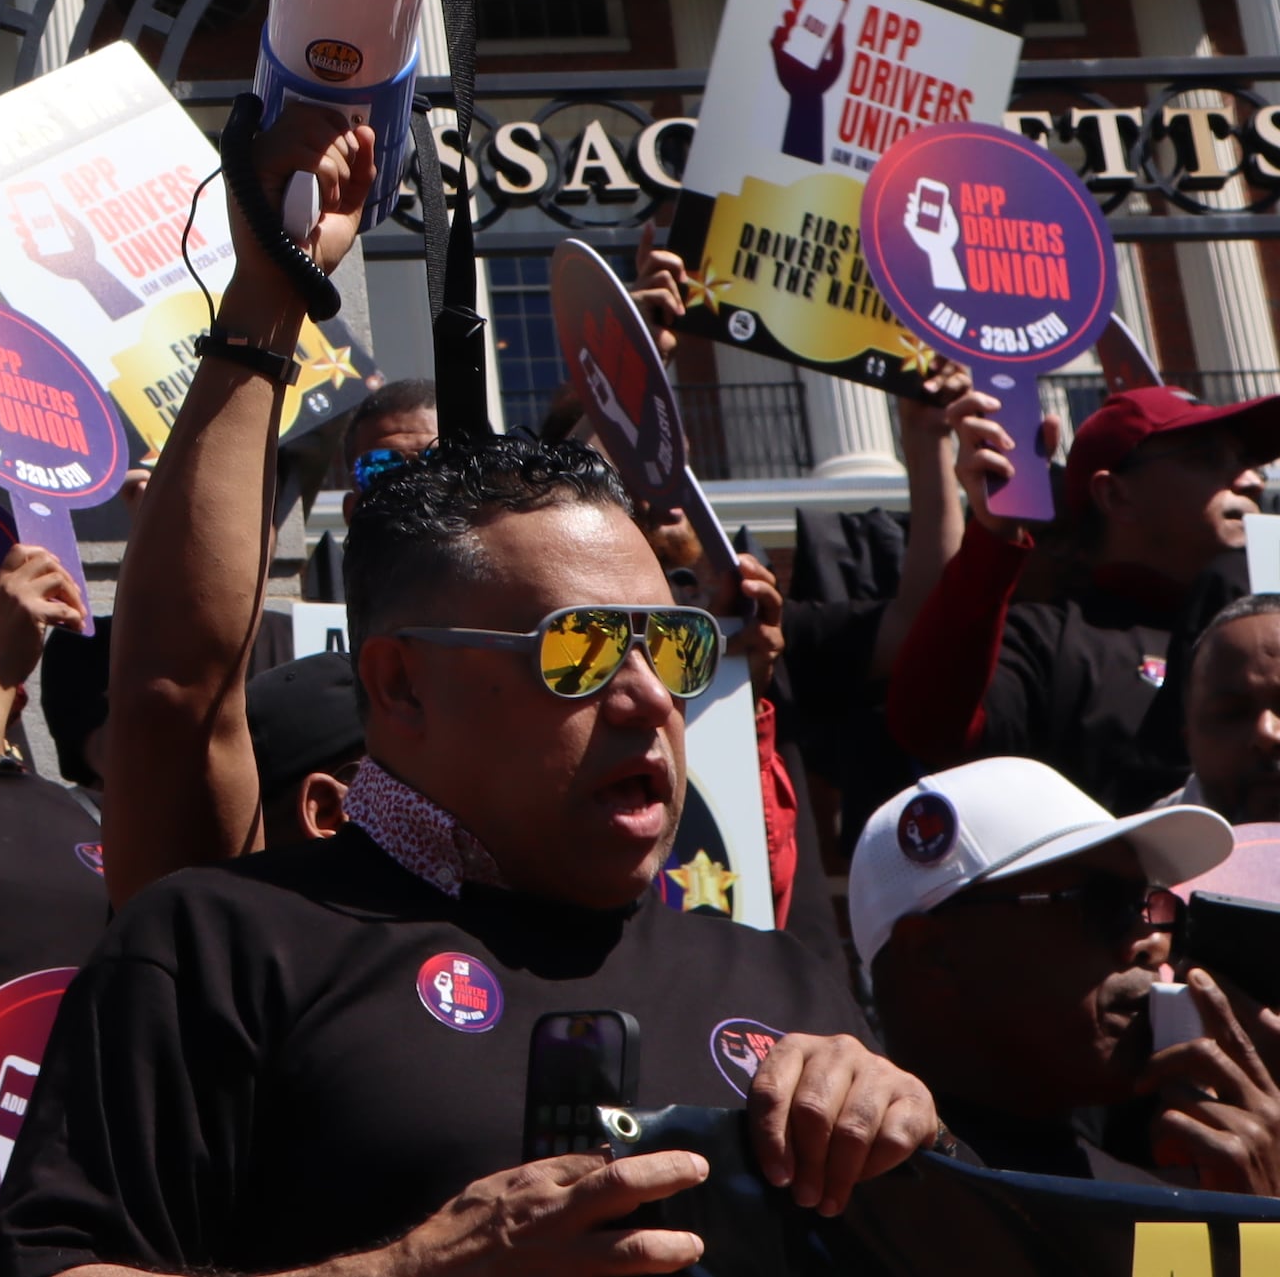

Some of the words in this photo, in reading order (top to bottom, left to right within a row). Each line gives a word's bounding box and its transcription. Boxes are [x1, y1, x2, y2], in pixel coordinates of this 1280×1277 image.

[858, 5, 922, 62] APP
[848, 51, 975, 124] DRIVERS
[61, 156, 121, 207] APP
[86, 165, 208, 244] DRIVERS
[960, 182, 1007, 215] APP
[112, 211, 208, 279] UNION
[739, 223, 840, 280] DRIVERS
[962, 215, 1066, 256] DRIVERS
[732, 249, 759, 282] IN
[774, 262, 815, 298] THE
[965, 247, 1071, 301] UNION
[928, 302, 967, 340] IAM
[980, 325, 1029, 353] 32BJ
[1026, 312, 1069, 349] SEIU
[15, 459, 60, 489] 32BJ
[55, 461, 92, 489] SEIU
[0, 1092, 28, 1116] ADU
